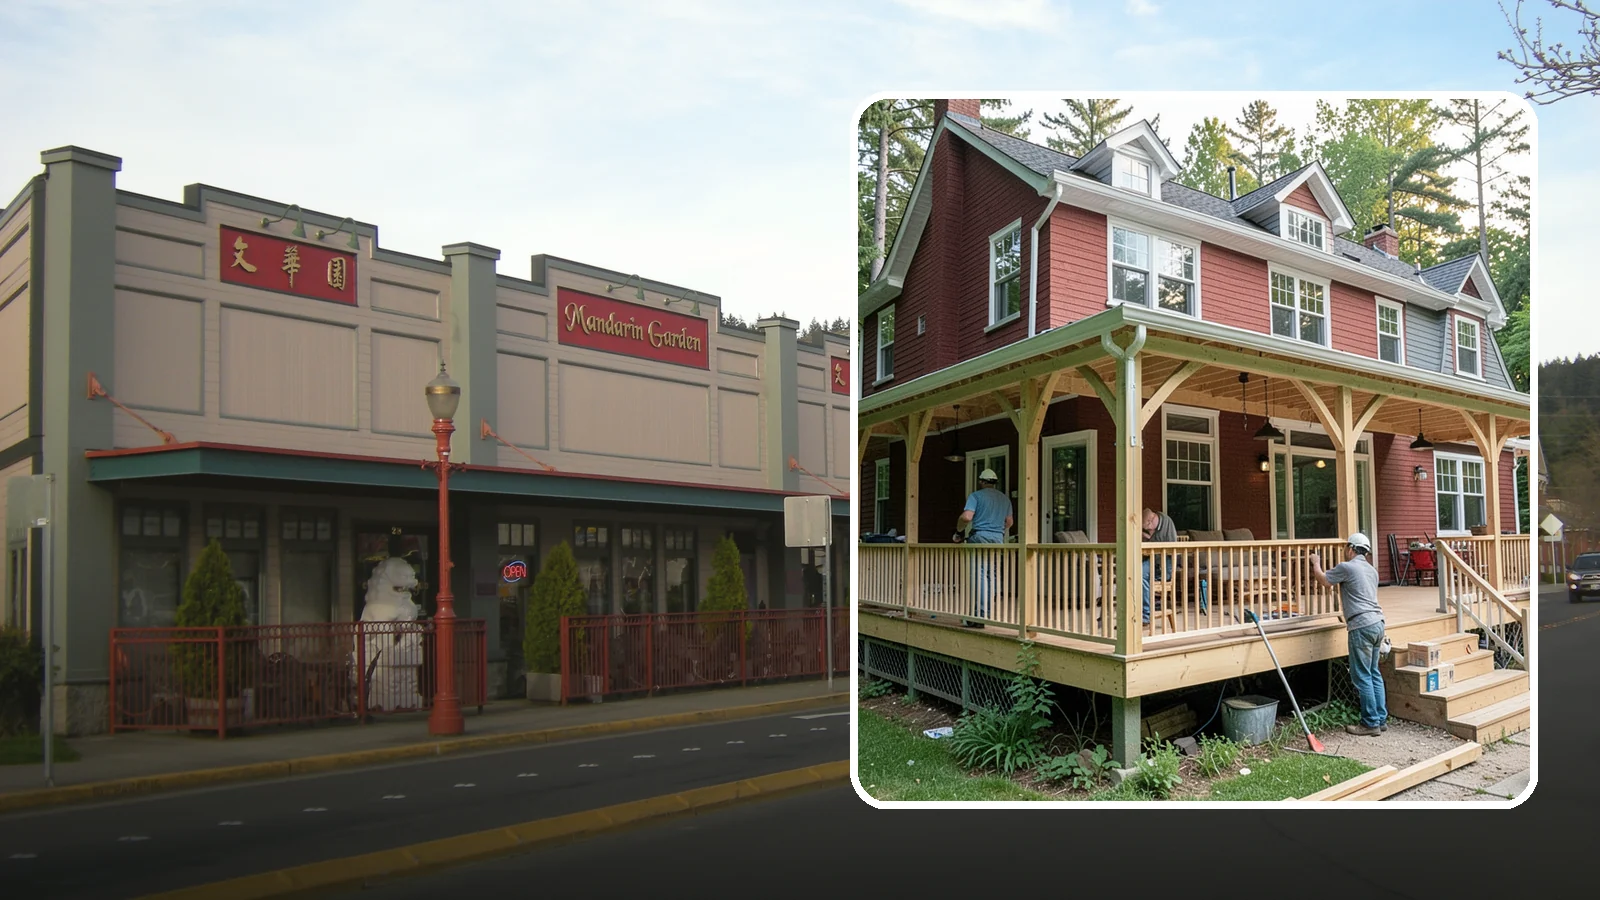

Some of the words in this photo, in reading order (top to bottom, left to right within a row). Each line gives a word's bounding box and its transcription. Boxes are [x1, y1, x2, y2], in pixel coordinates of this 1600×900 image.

[231, 236, 346, 290] 文華園
[564, 302, 644, 341] Mandarin
[648, 320, 702, 352] Garden
[503, 565, 526, 578] OPEN
